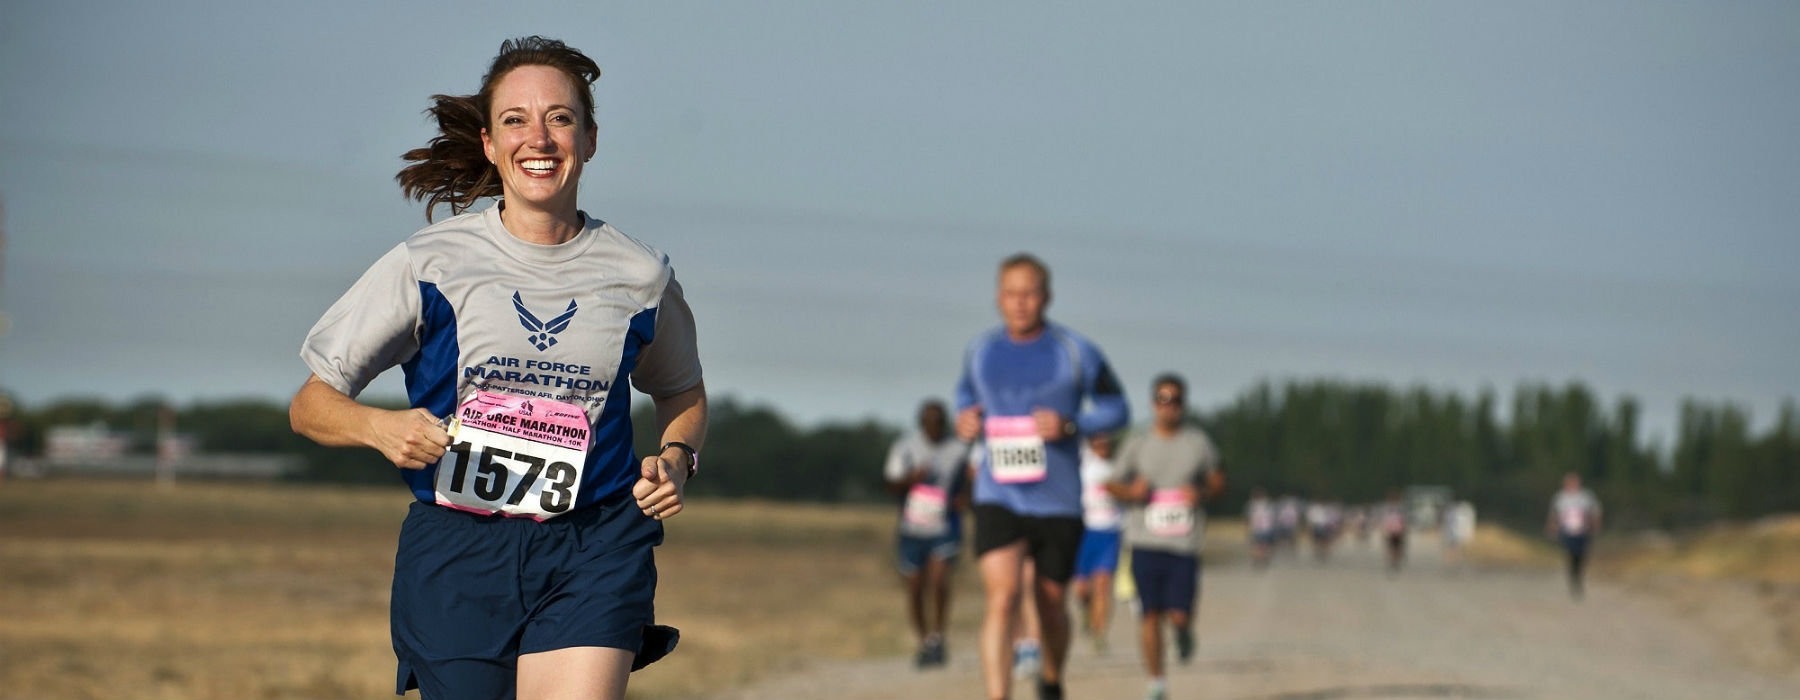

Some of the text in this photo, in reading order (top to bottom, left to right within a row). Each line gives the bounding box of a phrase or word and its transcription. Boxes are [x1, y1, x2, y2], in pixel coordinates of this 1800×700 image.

[464, 366, 609, 391] MARATHON
[486, 356, 591, 376] AIR FORCE
[483, 412, 517, 426] ORCE
[519, 418, 587, 440] MARATHON
[502, 425, 521, 433] HALF
[522, 429, 563, 443] MARATHON
[568, 439, 582, 447] 10K
[450, 440, 577, 513] 1573
